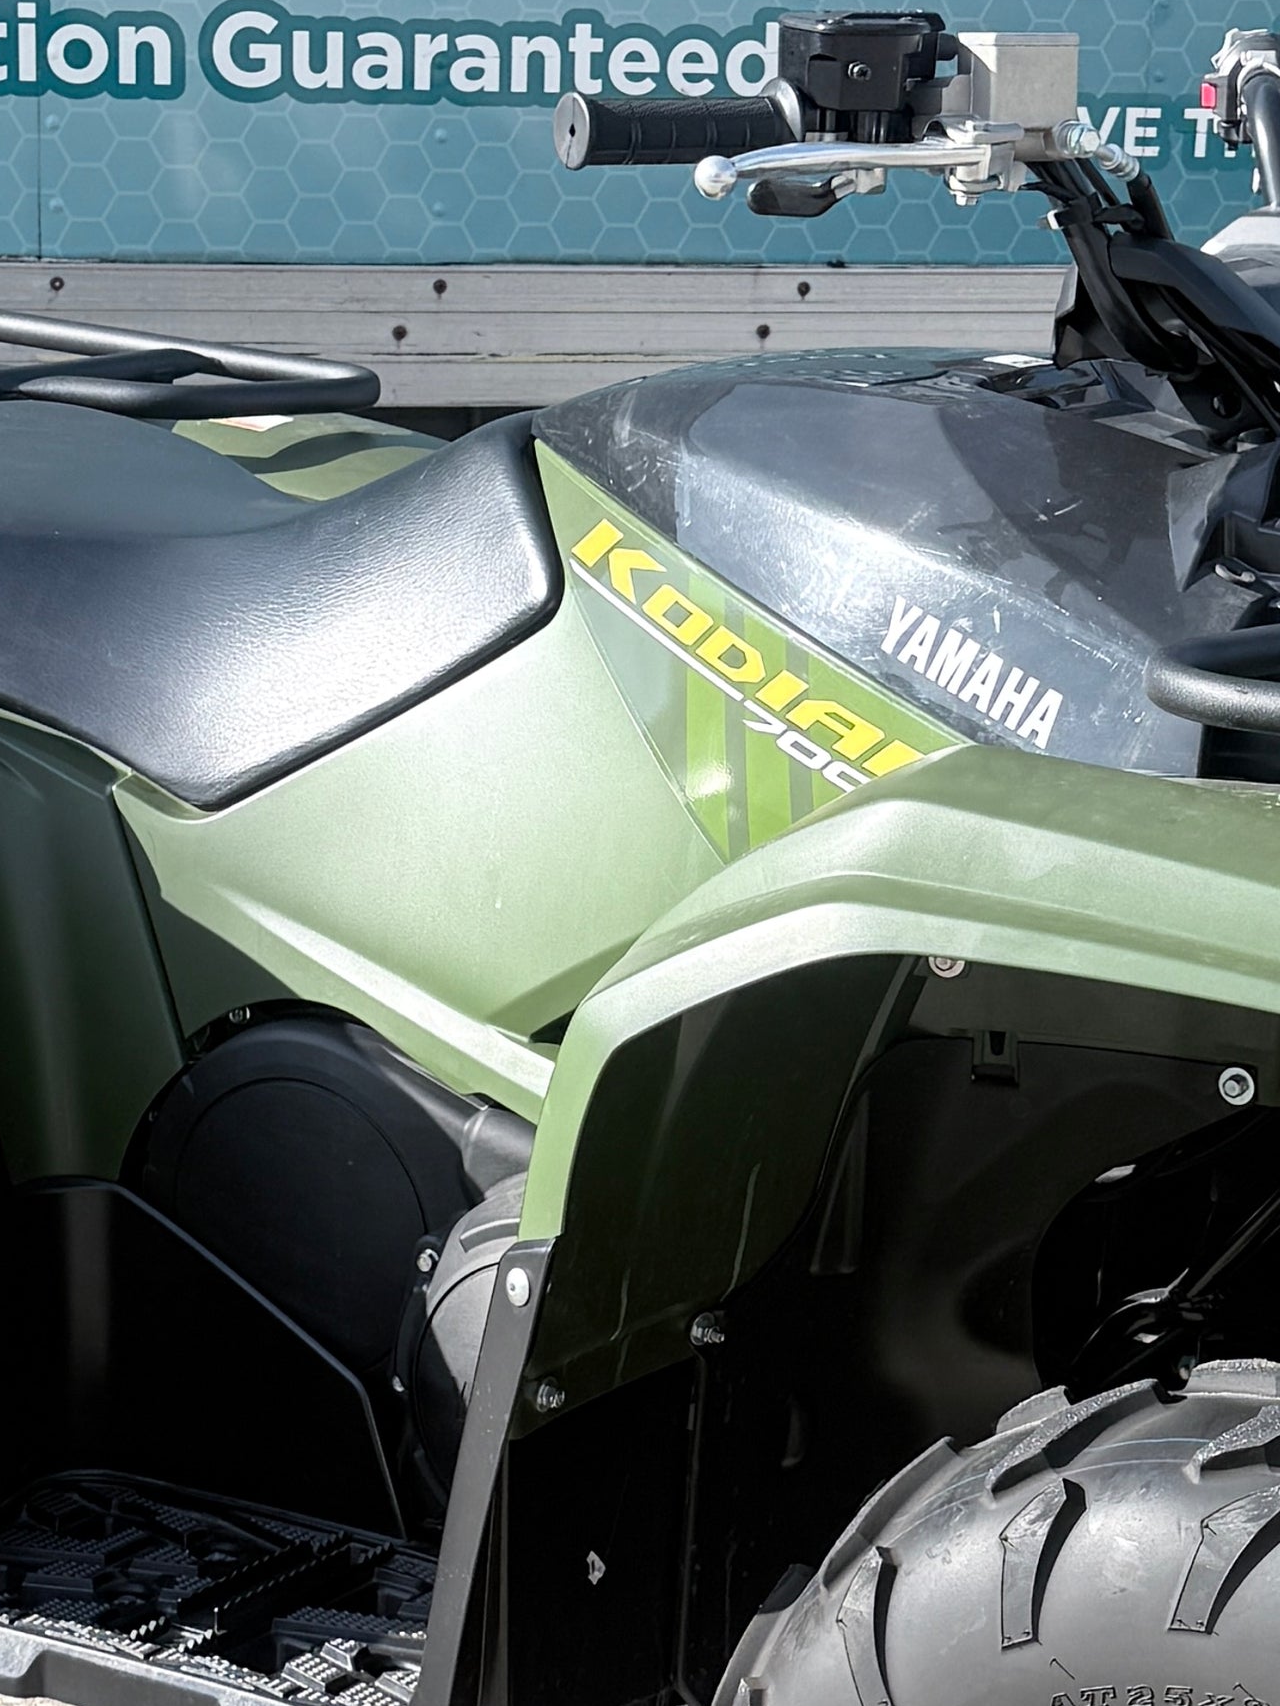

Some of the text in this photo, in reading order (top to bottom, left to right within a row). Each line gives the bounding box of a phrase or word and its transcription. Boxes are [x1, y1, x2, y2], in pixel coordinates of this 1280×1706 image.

[213, 11, 780, 97] Guaranteed
[1077, 107, 1162, 157] VE
[879, 598, 1064, 749] YAMAHA
